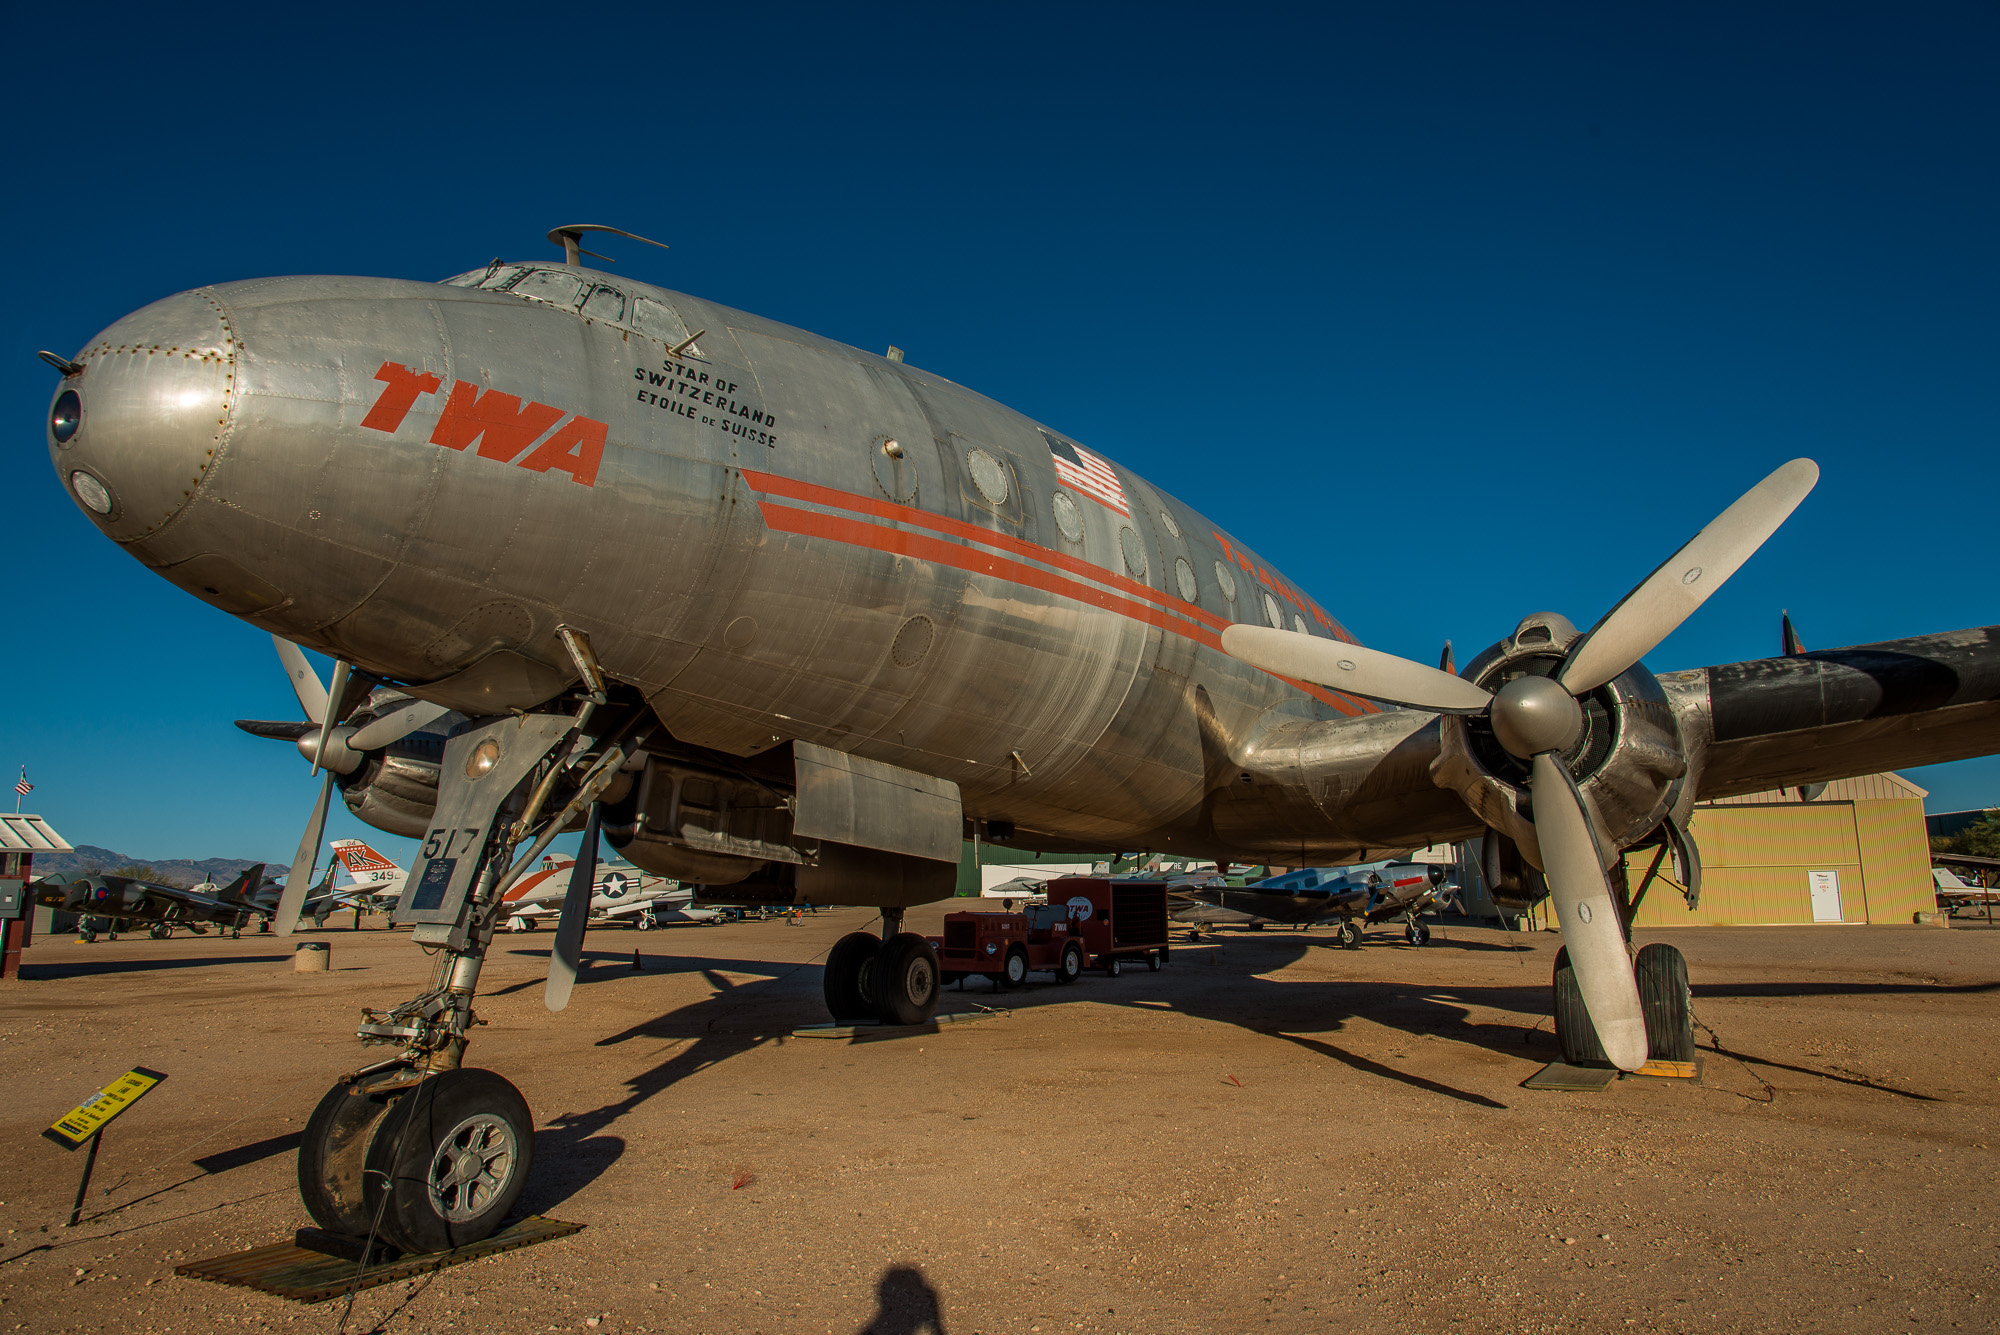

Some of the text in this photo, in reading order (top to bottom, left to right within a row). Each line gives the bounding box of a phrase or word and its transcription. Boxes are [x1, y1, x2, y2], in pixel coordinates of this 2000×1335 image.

[663, 360, 738, 394] STAR OF
[634, 367, 777, 428] SWITZERLAND
[360, 361, 609, 488] TWA
[637, 389, 777, 449] ETOILE DE SUISSE
[1211, 530, 1306, 612] TRANS
[347, 849, 385, 867] AK
[423, 828, 480, 859] 517
[1173, 862, 1182, 870] RE
[665, 878, 679, 886] 104
[1069, 904, 1089, 913] TWA
[1054, 923, 1067, 931] TWA
